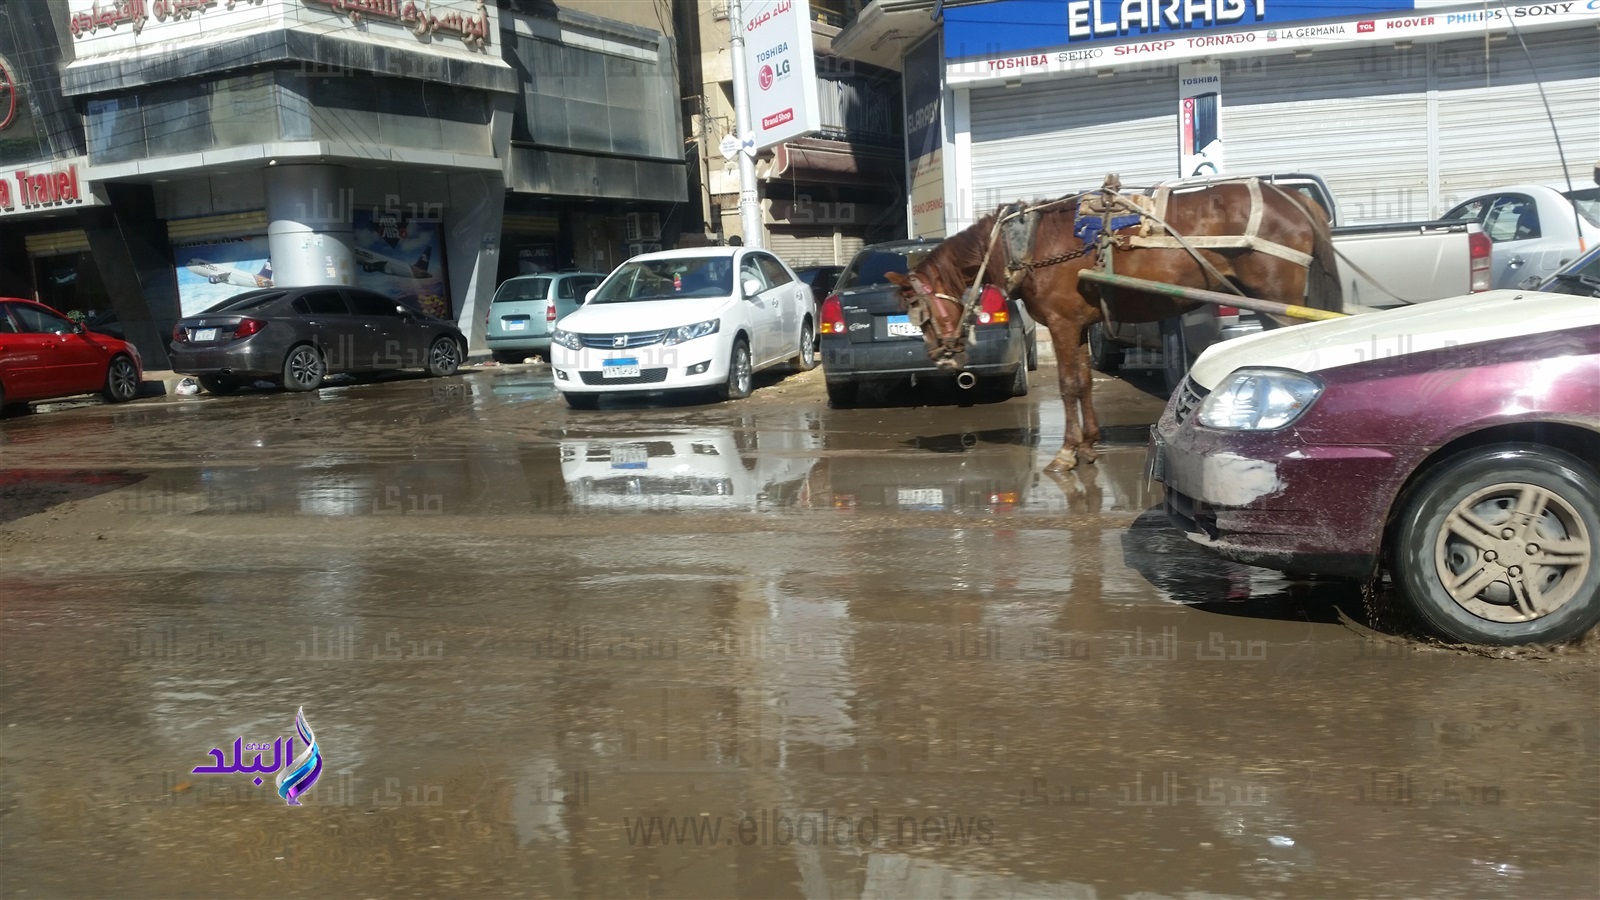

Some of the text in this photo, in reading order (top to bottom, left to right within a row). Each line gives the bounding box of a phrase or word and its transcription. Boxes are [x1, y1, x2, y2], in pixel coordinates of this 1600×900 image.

[988, 55, 1048, 71] TOSHIBA
[1058, 49, 1103, 62] SEIKO
[1114, 41, 1175, 56] SHARP
[1187, 33, 1256, 49] TORNADO
[1281, 29, 1294, 39] LA
[1296, 25, 1346, 38] GERMANIA
[1359, 23, 1374, 31] TCL
[1386, 17, 1435, 29] HOOVER
[1447, 9, 1502, 24] PHILIPS
[1514, 2, 1575, 18] SONY
[756, 42, 788, 63] TOSHIBA
[776, 59, 790, 77] LG
[1182, 76, 1218, 86] TOSHIBA
[764, 111, 791, 127] Brand Shop
[15, 164, 79, 206] Travel
